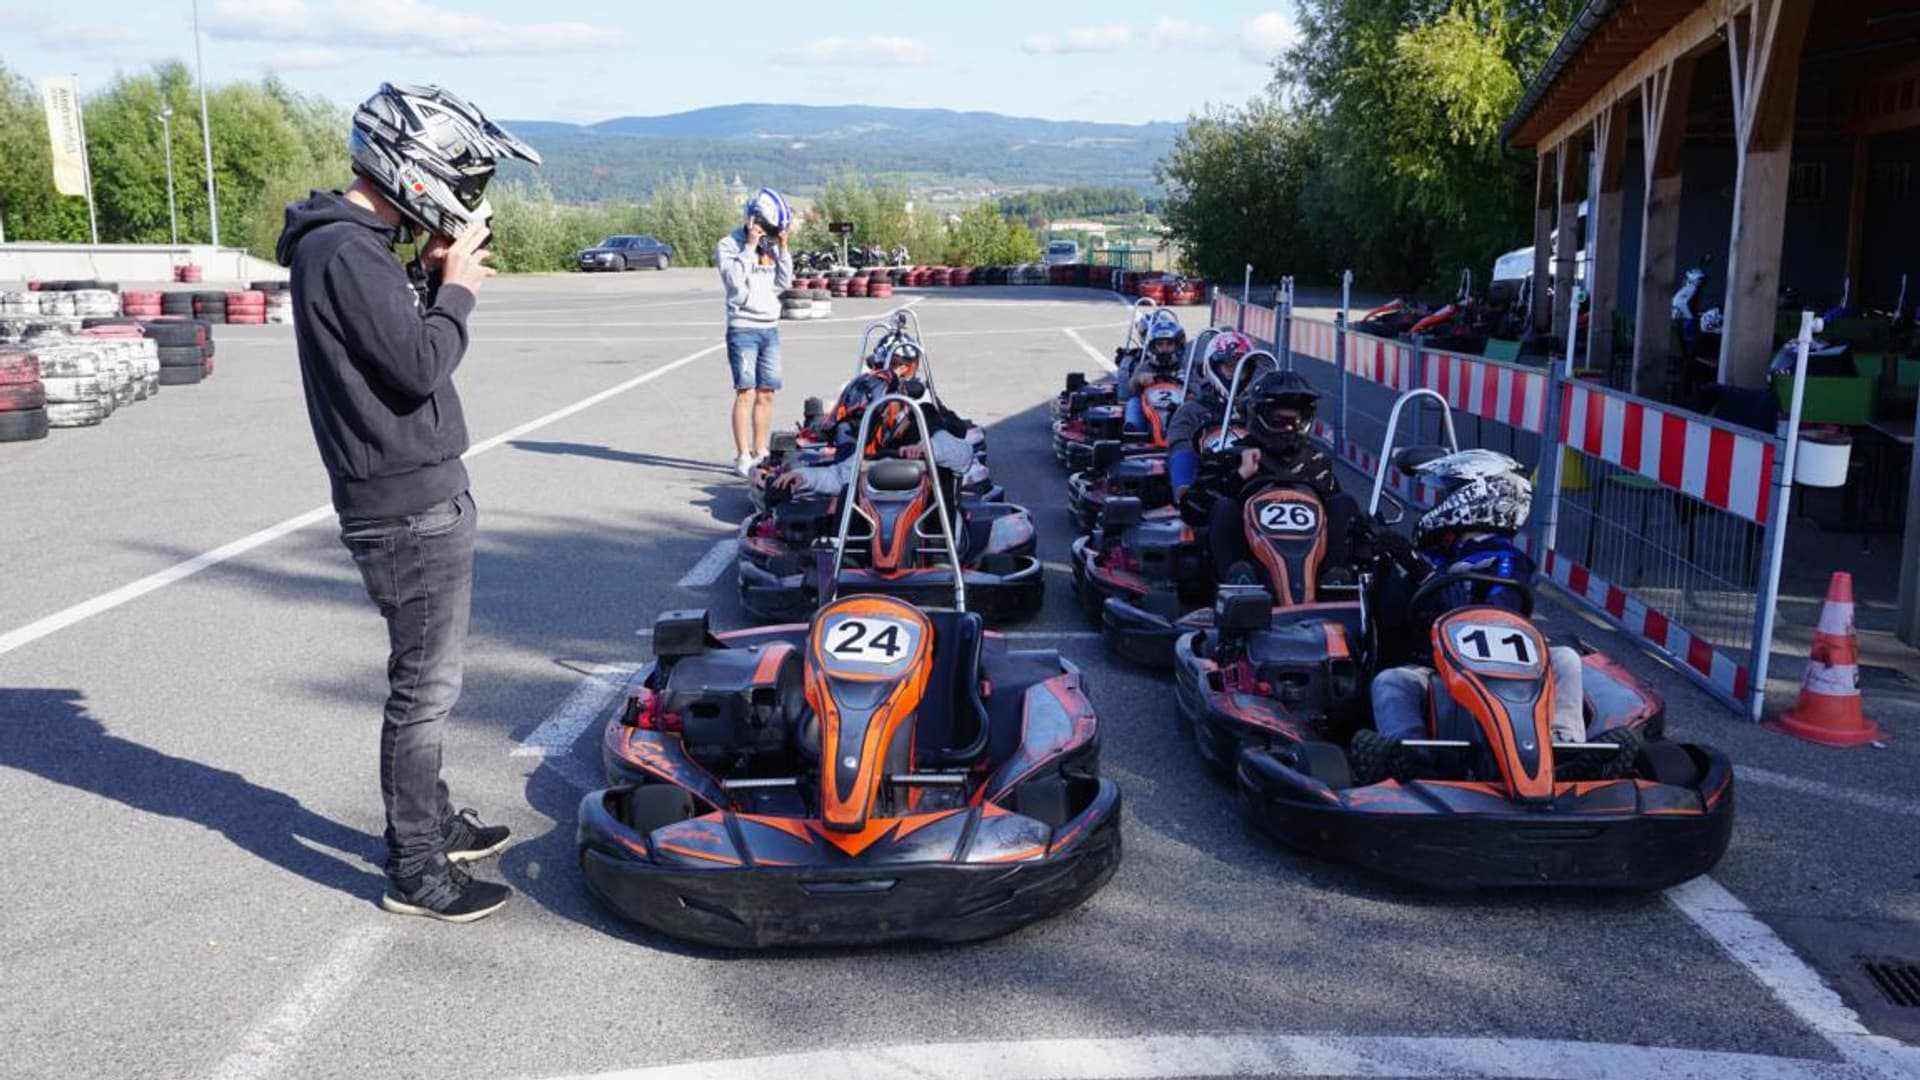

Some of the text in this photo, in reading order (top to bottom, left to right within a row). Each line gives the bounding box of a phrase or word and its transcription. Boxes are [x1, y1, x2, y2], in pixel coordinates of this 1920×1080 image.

[1266, 505, 1310, 526] 26
[833, 621, 901, 657] 24
[1462, 629, 1530, 663] 11
